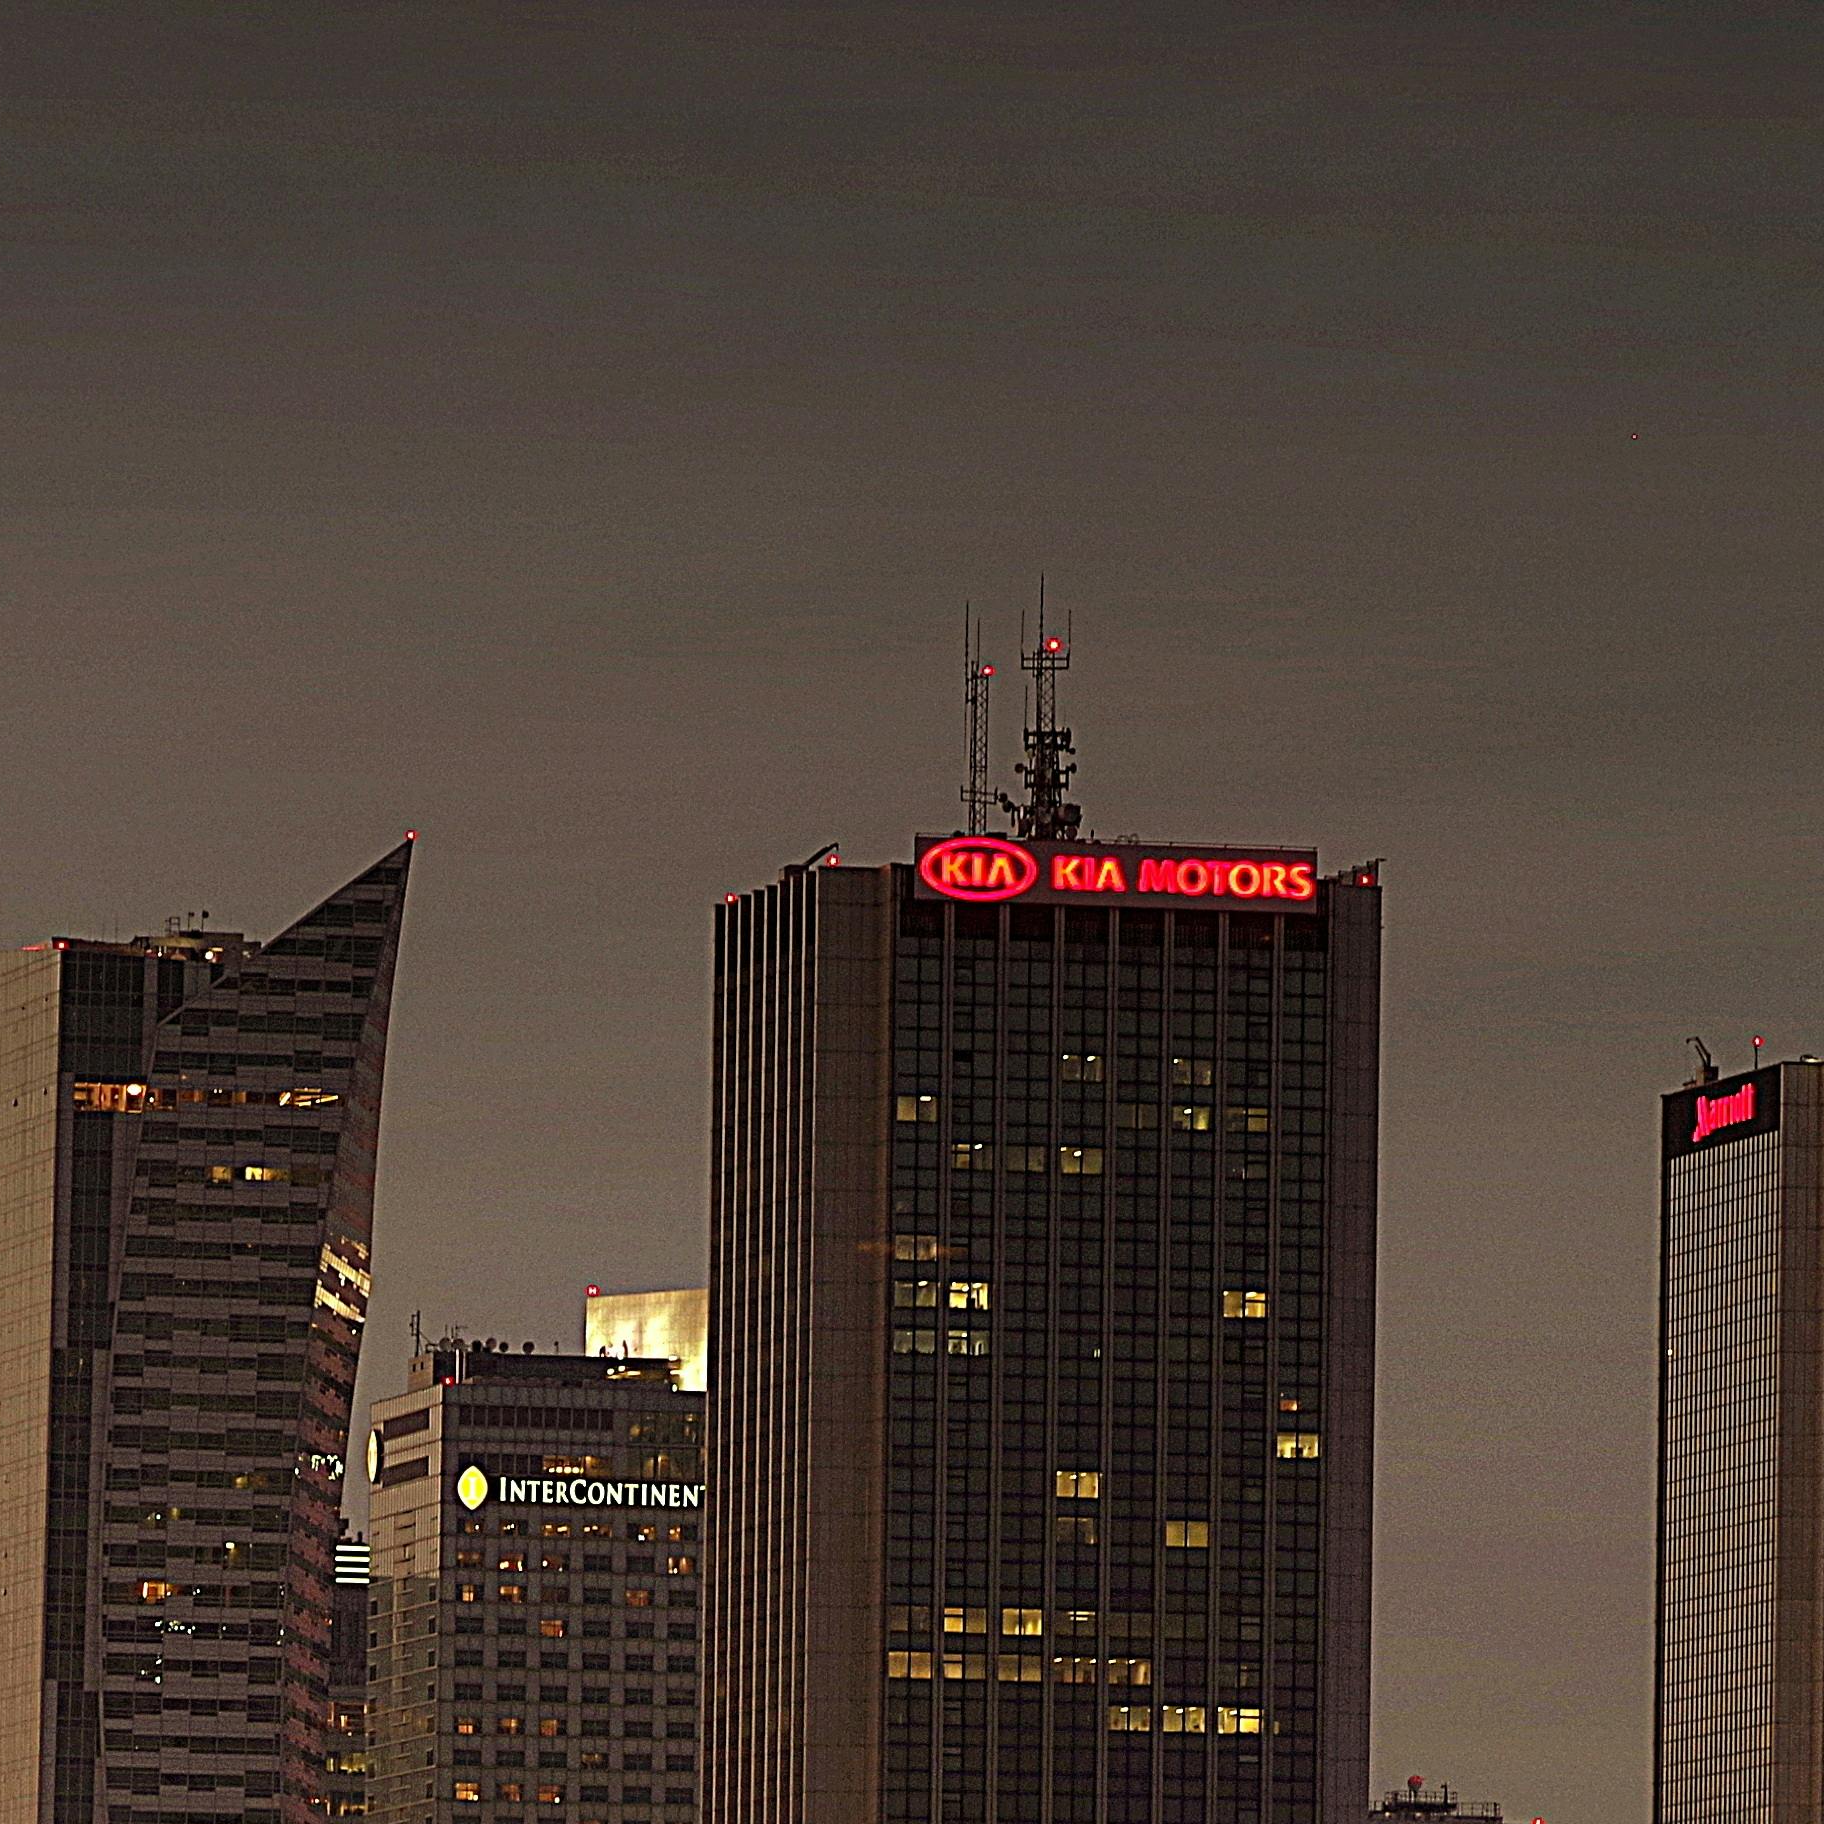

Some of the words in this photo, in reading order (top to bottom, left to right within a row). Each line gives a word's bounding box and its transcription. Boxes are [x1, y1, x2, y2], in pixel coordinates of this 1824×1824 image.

[941, 851, 1016, 888] KIA
[1052, 854, 1126, 893] KIA
[1137, 858, 1315, 900] MOTORS
